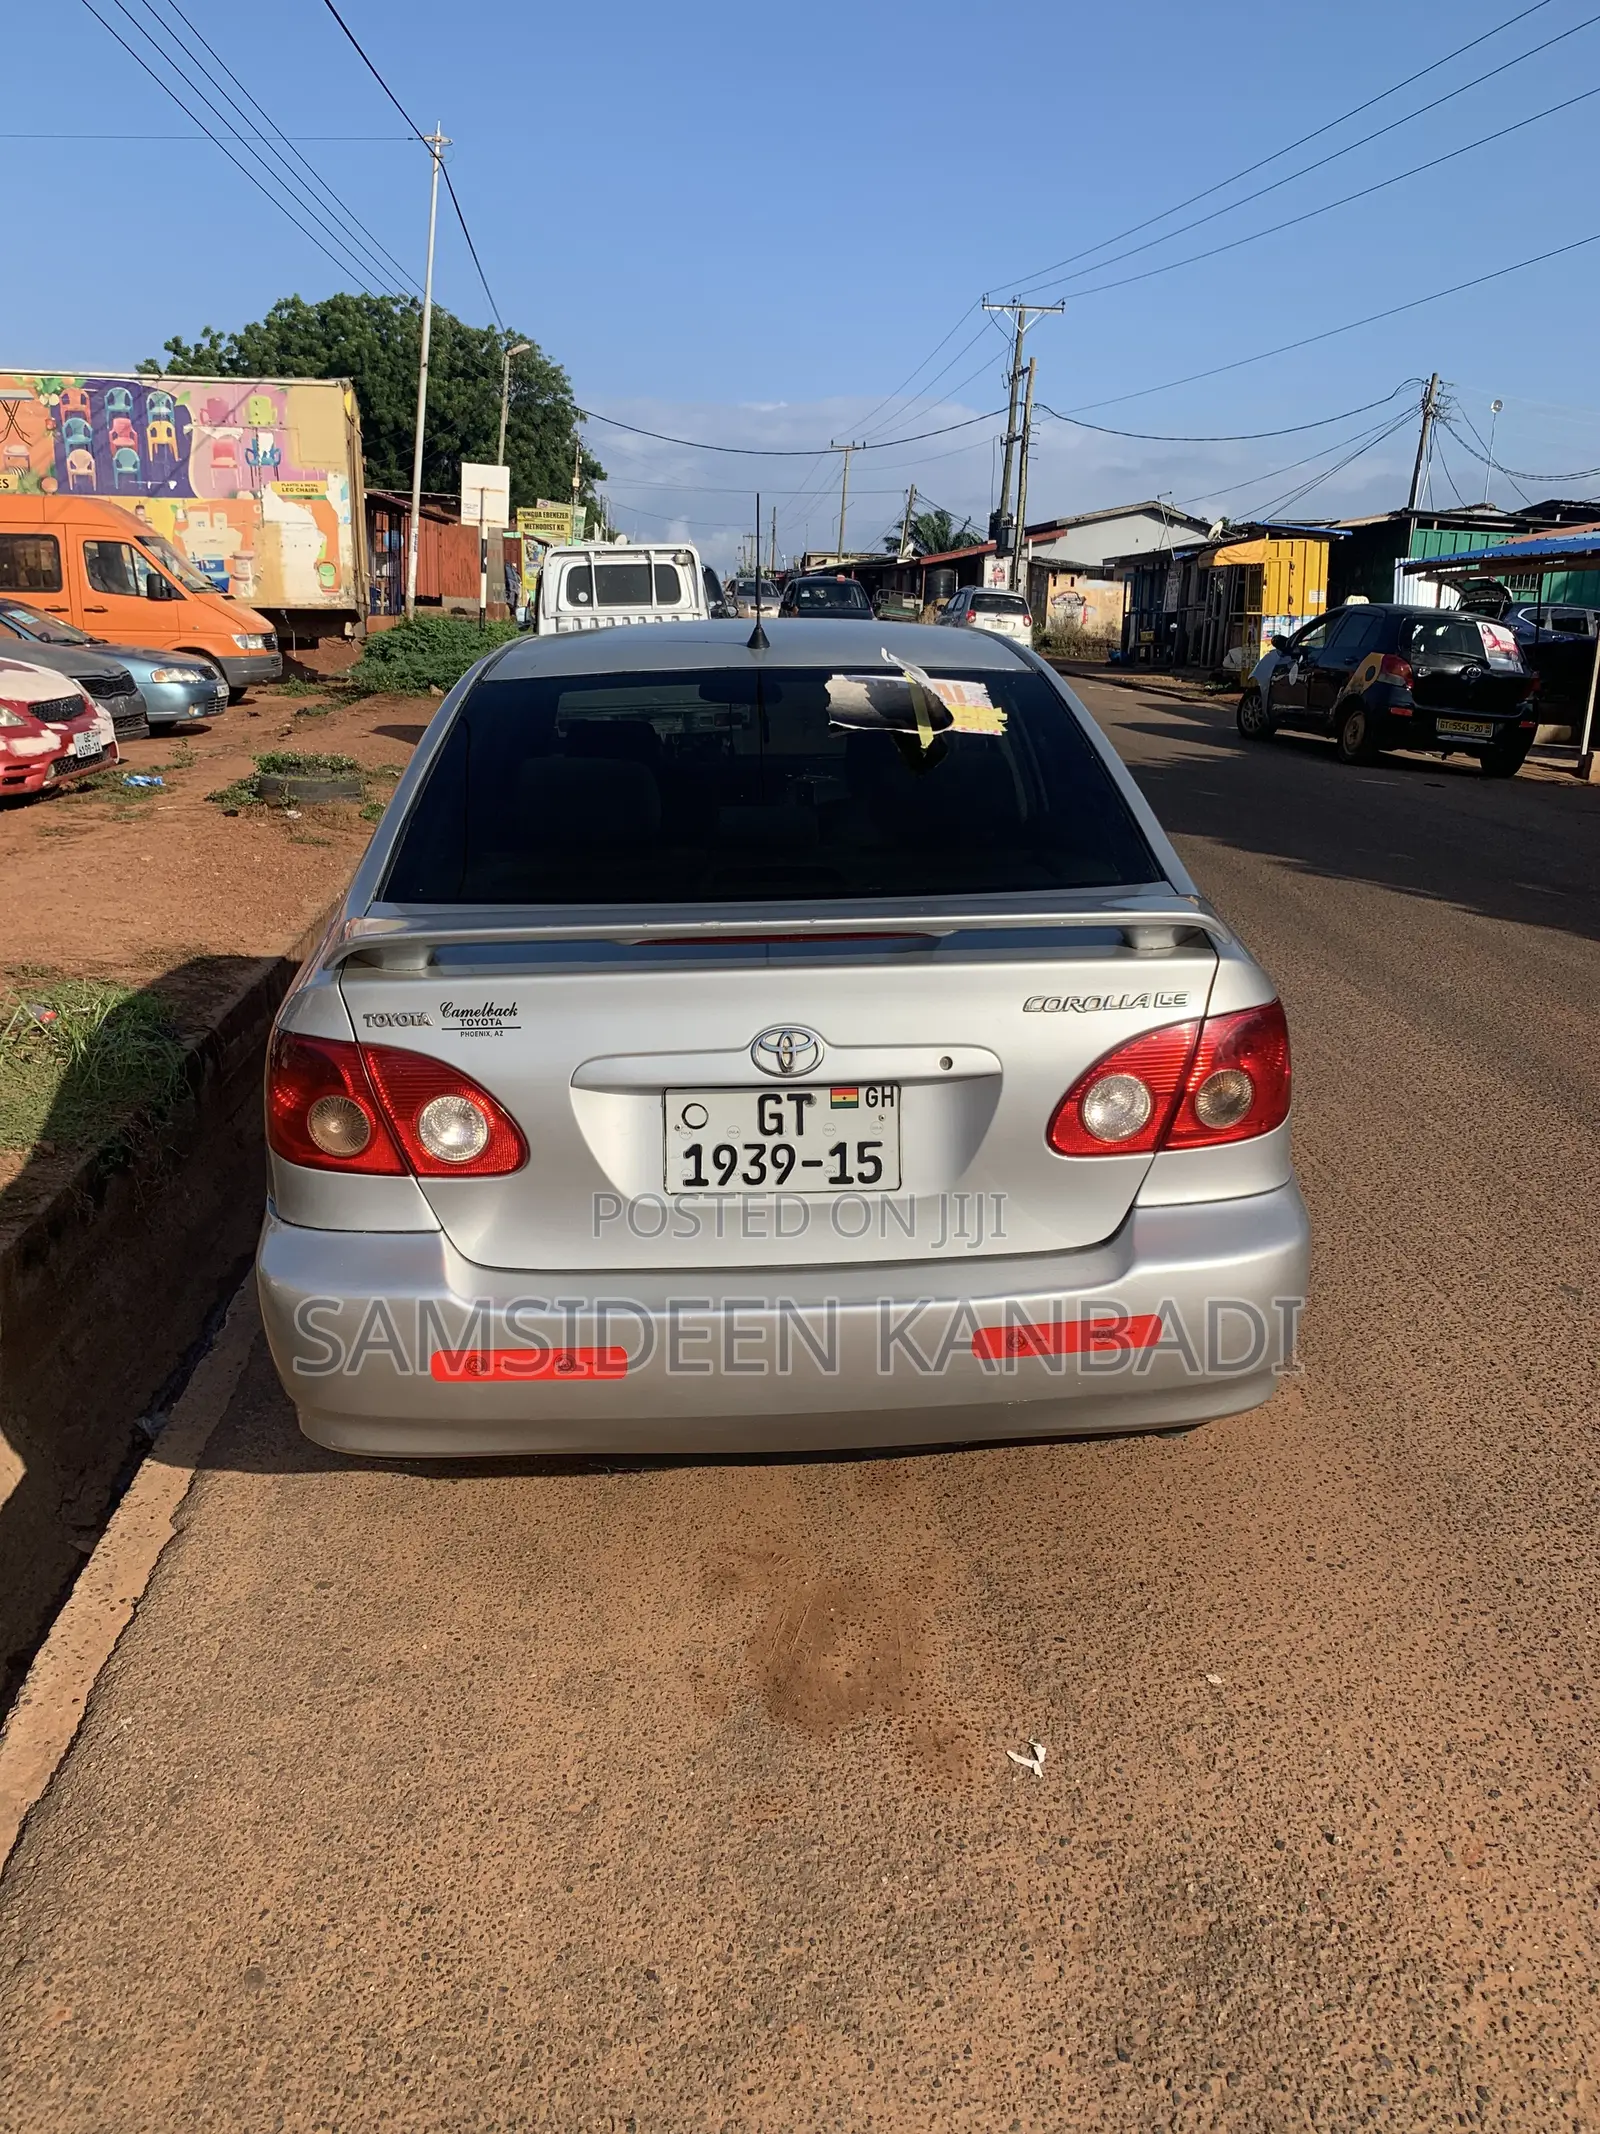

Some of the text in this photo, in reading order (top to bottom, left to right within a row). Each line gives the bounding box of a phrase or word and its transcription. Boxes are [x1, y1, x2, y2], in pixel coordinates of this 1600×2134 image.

[440, 1001, 518, 1018] Camelback
[1023, 993, 1189, 1013] COROLLA LE
[363, 1012, 433, 1027] TOYOTA
[460, 1018, 502, 1027] TOYOTA
[758, 1086, 894, 1136] GT GH
[683, 1141, 883, 1186] 1939-15
